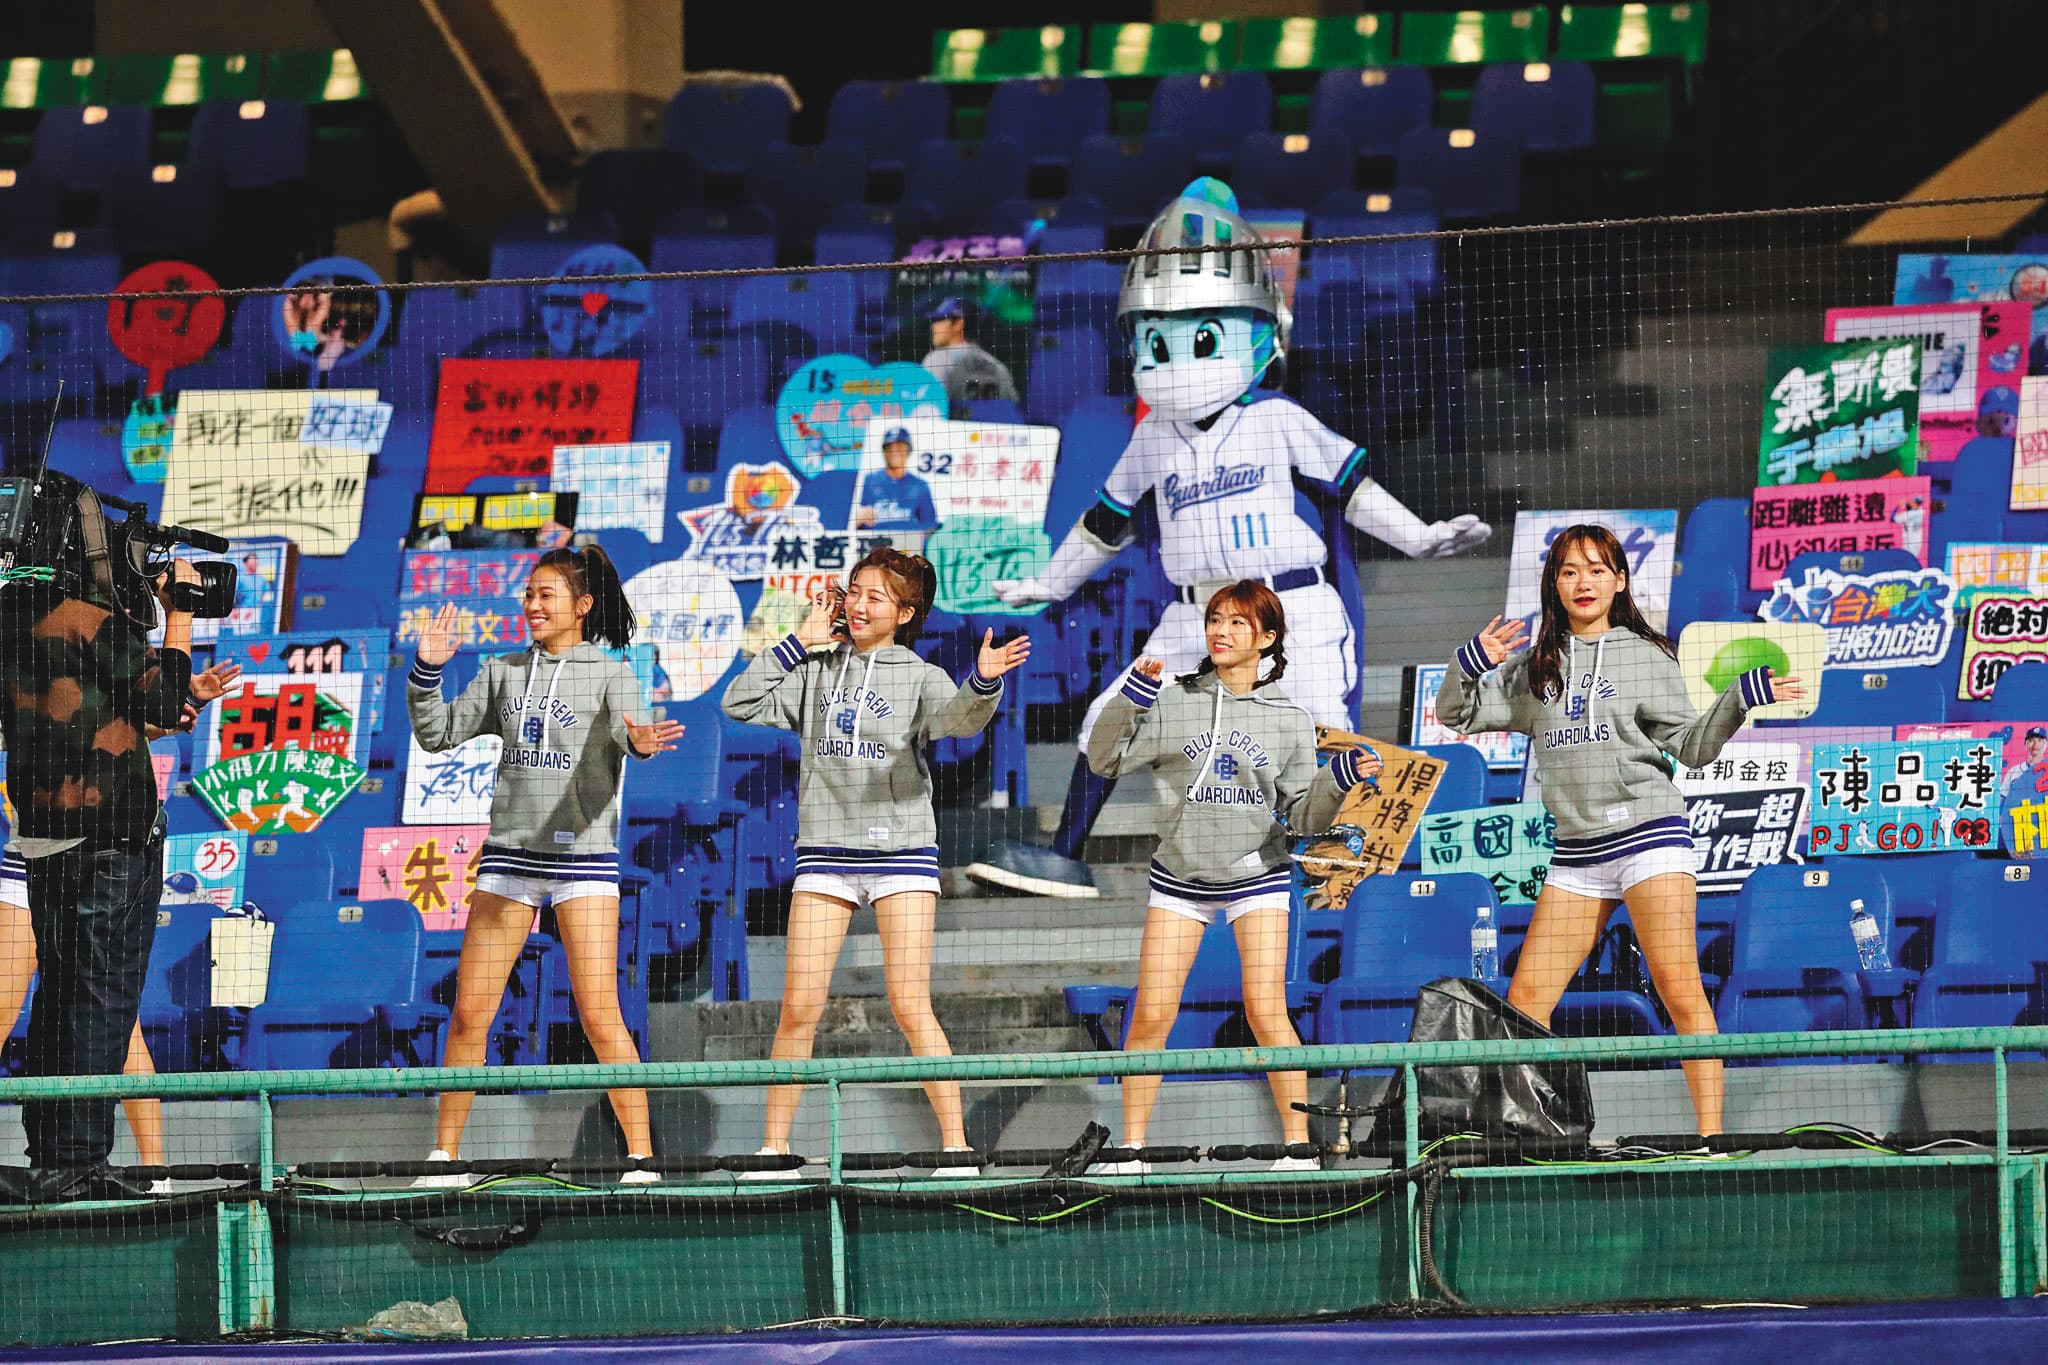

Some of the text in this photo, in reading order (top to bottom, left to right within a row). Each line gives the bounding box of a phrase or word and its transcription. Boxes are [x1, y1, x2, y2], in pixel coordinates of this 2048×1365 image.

[808, 369, 836, 393] 15
[917, 452, 952, 475] 32
[1164, 464, 1265, 520] Guardians
[1754, 493, 1885, 529] 距離雖遠
[1232, 512, 1268, 549] 111
[853, 686, 893, 719] CREW
[502, 748, 571, 770] GUARDIANS
[817, 739, 886, 760] GUARDANS
[1229, 730, 1269, 768] CREW
[256, 779, 269, 801] K
[1819, 748, 1996, 812] 陳品捷
[1811, 825, 1851, 853] PJ
[1954, 818, 1991, 846] 93
[201, 841, 236, 871] 35
[262, 842, 270, 854] 2
[1812, 872, 1820, 885] 9
[2013, 867, 2022, 880] 8
[1417, 883, 1430, 895] 11
